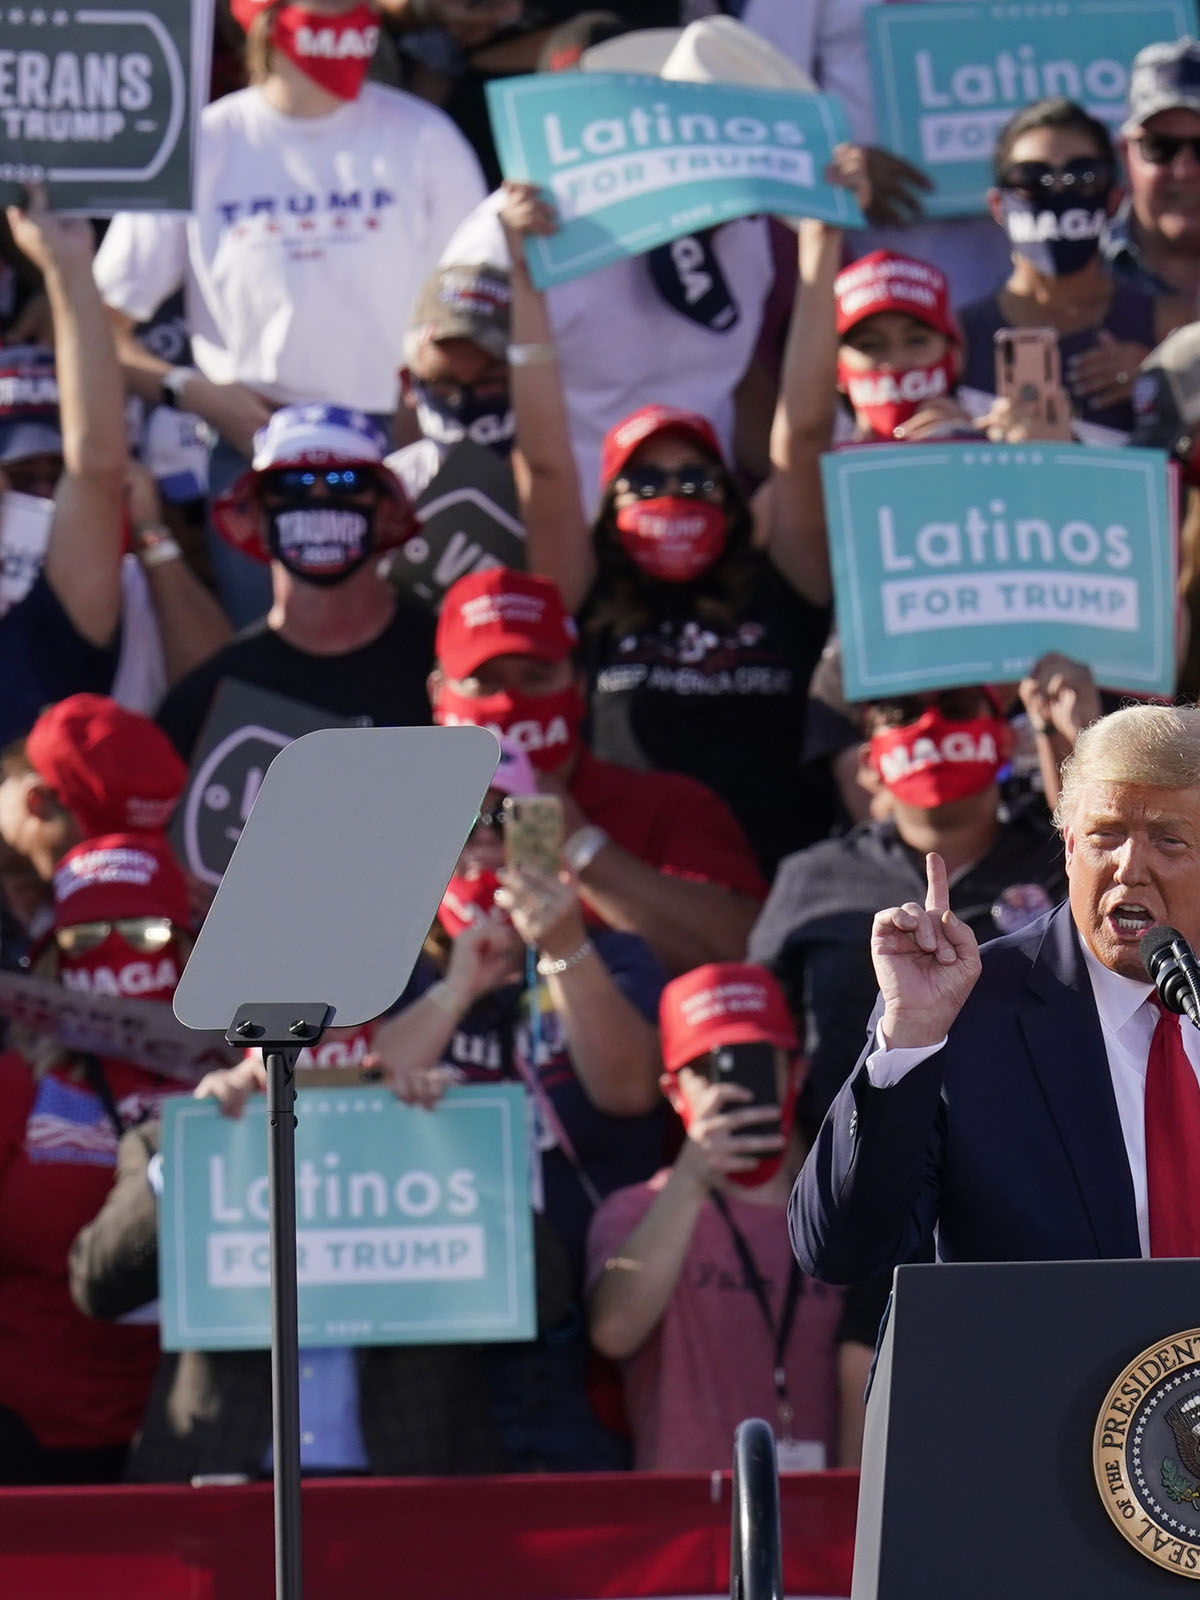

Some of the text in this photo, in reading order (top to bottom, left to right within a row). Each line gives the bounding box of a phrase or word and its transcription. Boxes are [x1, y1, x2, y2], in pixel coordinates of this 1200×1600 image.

[916, 45, 1127, 109] Latino
[6, 110, 125, 144] TRUMP
[545, 104, 806, 165] Latinos
[568, 153, 799, 202] FOR TRUMP
[218, 188, 396, 223] TRUMP
[878, 499, 1133, 571] Latinos
[898, 581, 1127, 619] FOR TRUMP
[882, 733, 998, 785] MAGA
[62, 961, 178, 998] MAGA
[329, 1237, 470, 1269] TRUMP
[1104, 1460, 1122, 1495] THE
[1115, 1498, 1136, 1520] OF
[1137, 1517, 1200, 1570] SEAL
